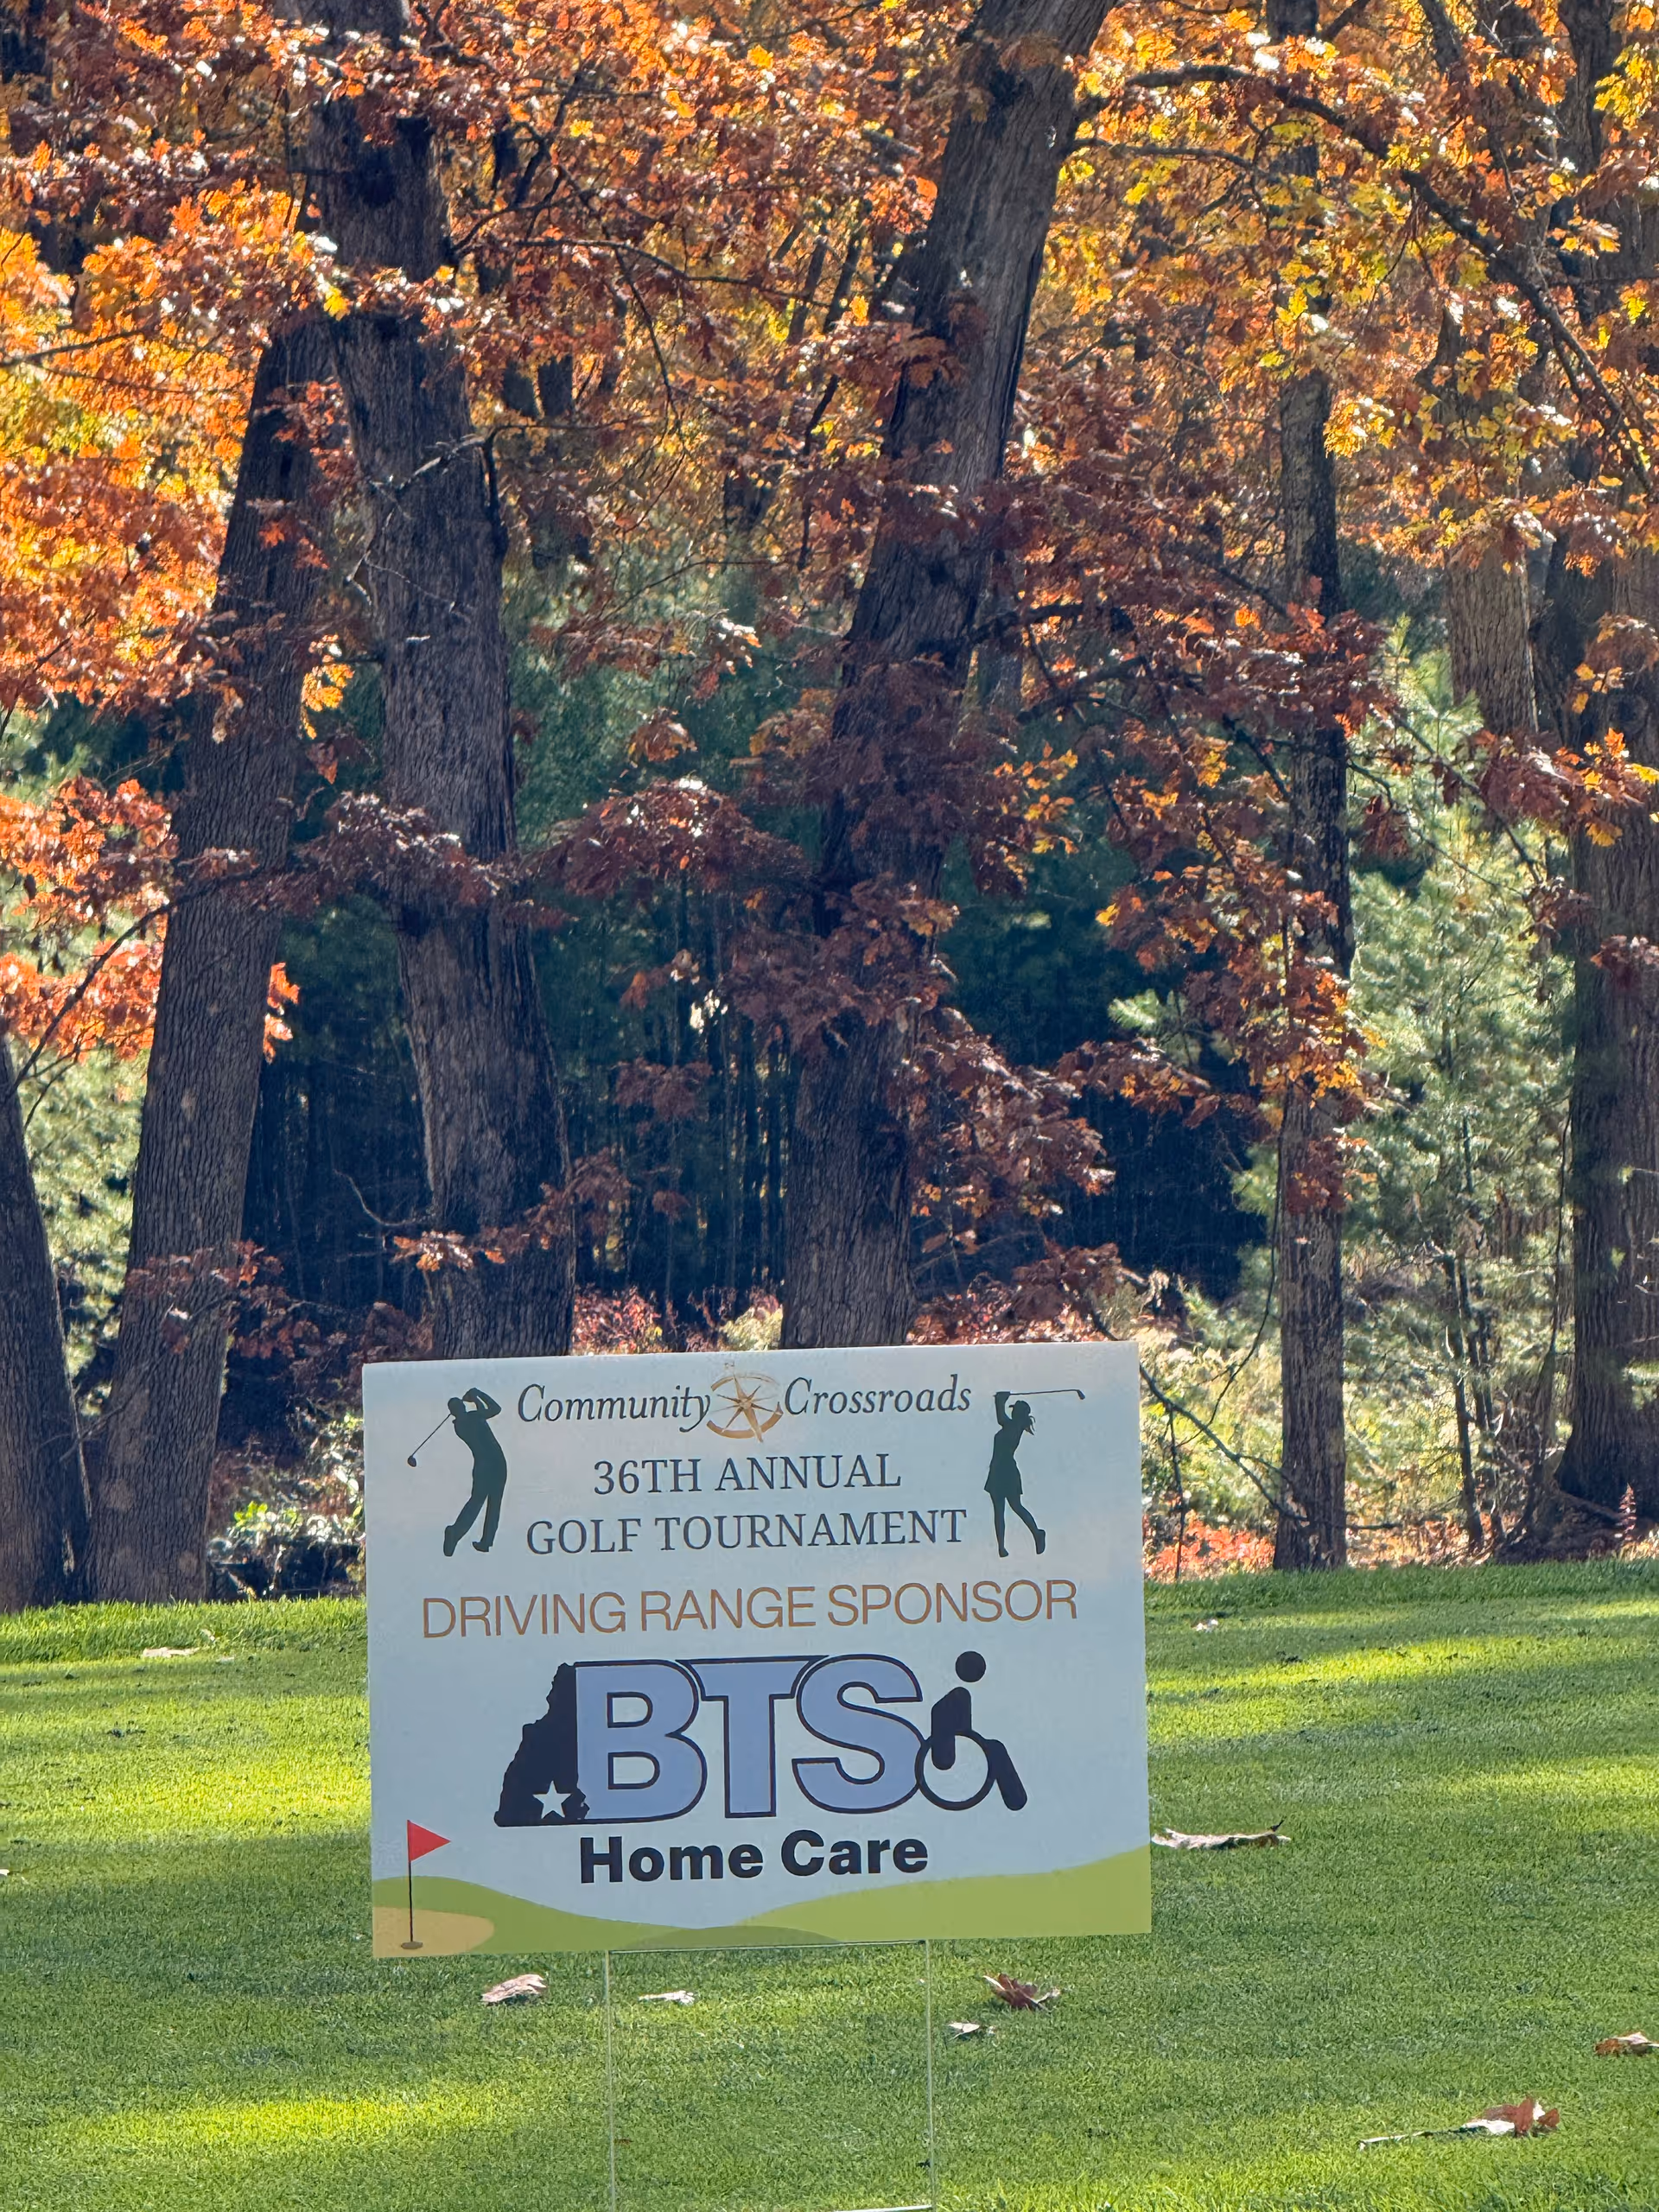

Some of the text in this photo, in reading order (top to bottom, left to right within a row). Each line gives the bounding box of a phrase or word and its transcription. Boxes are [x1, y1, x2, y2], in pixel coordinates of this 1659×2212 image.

[518, 1374, 972, 1433] Community Crossroads
[594, 1452, 902, 1495] 36TH ANNUAL
[526, 1510, 968, 1556] GOLF TOURNAMENT
[423, 1580, 1078, 1639] DRIVING RANGE SPONSOR
[574, 1654, 927, 1821] BTS
[580, 1829, 929, 1884] Home Care
